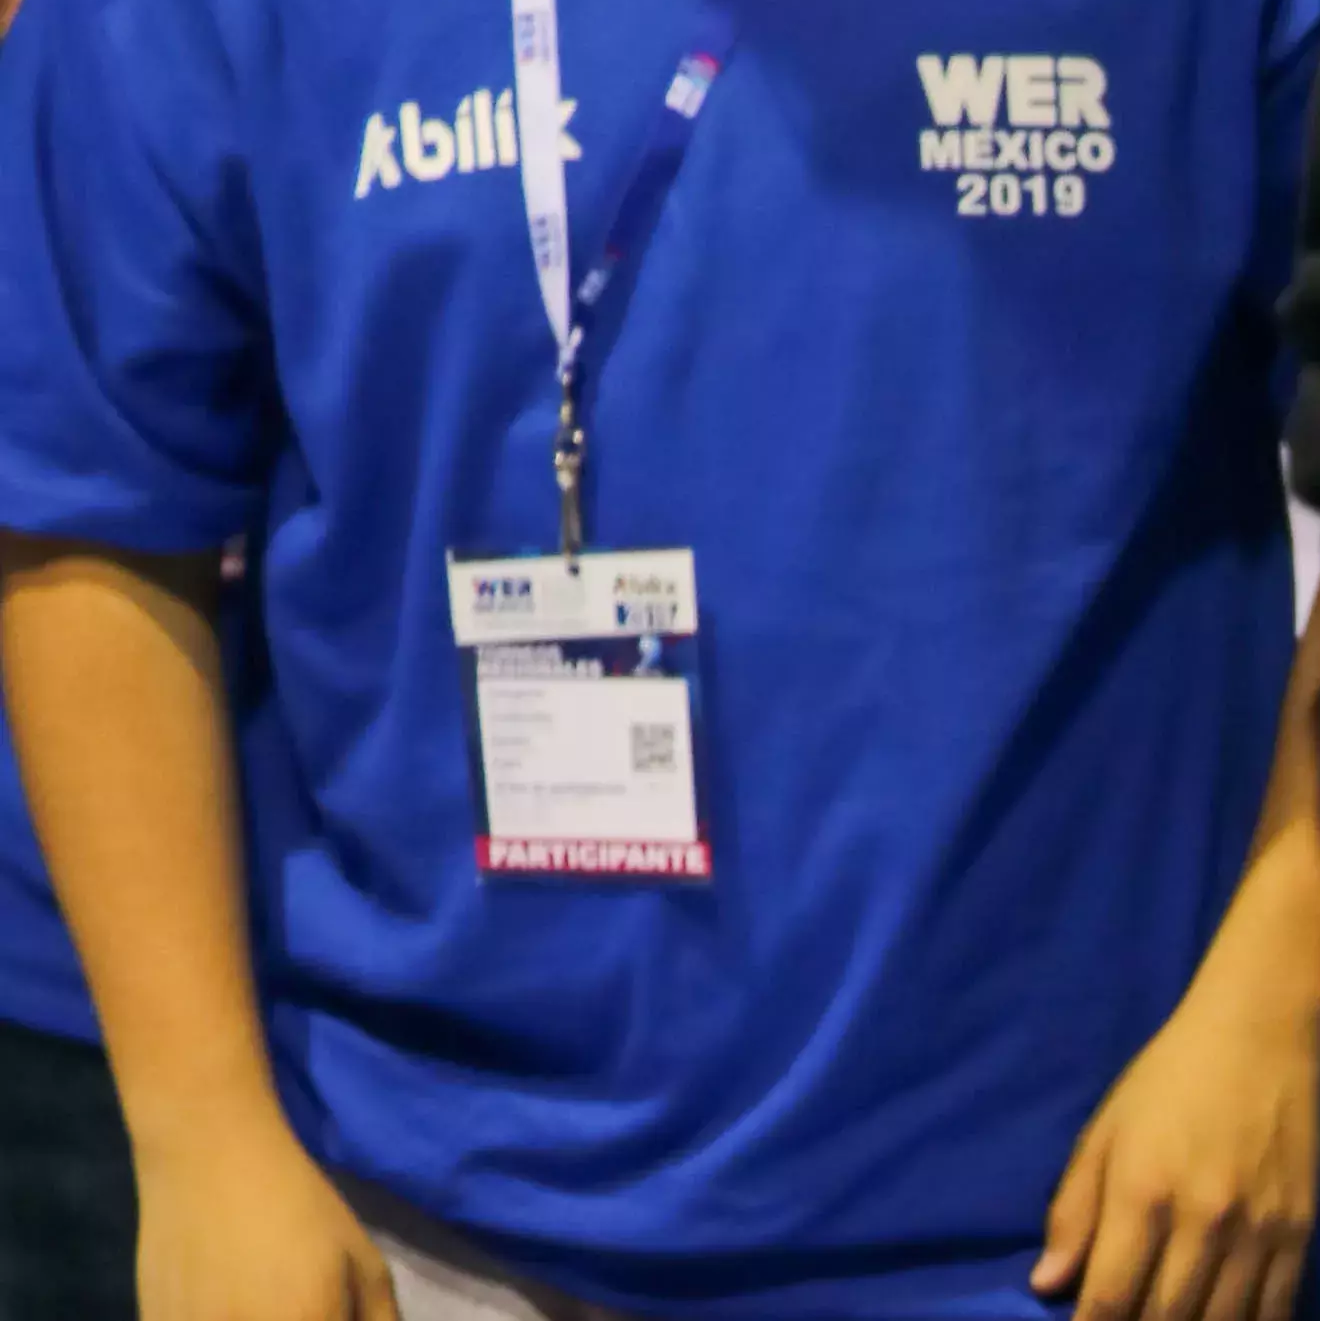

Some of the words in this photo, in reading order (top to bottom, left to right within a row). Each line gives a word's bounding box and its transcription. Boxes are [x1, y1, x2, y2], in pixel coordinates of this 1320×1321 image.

[916, 54, 1111, 128] WER
[955, 173, 1086, 217] 2019
[489, 838, 705, 875] PARTICIPANTE
